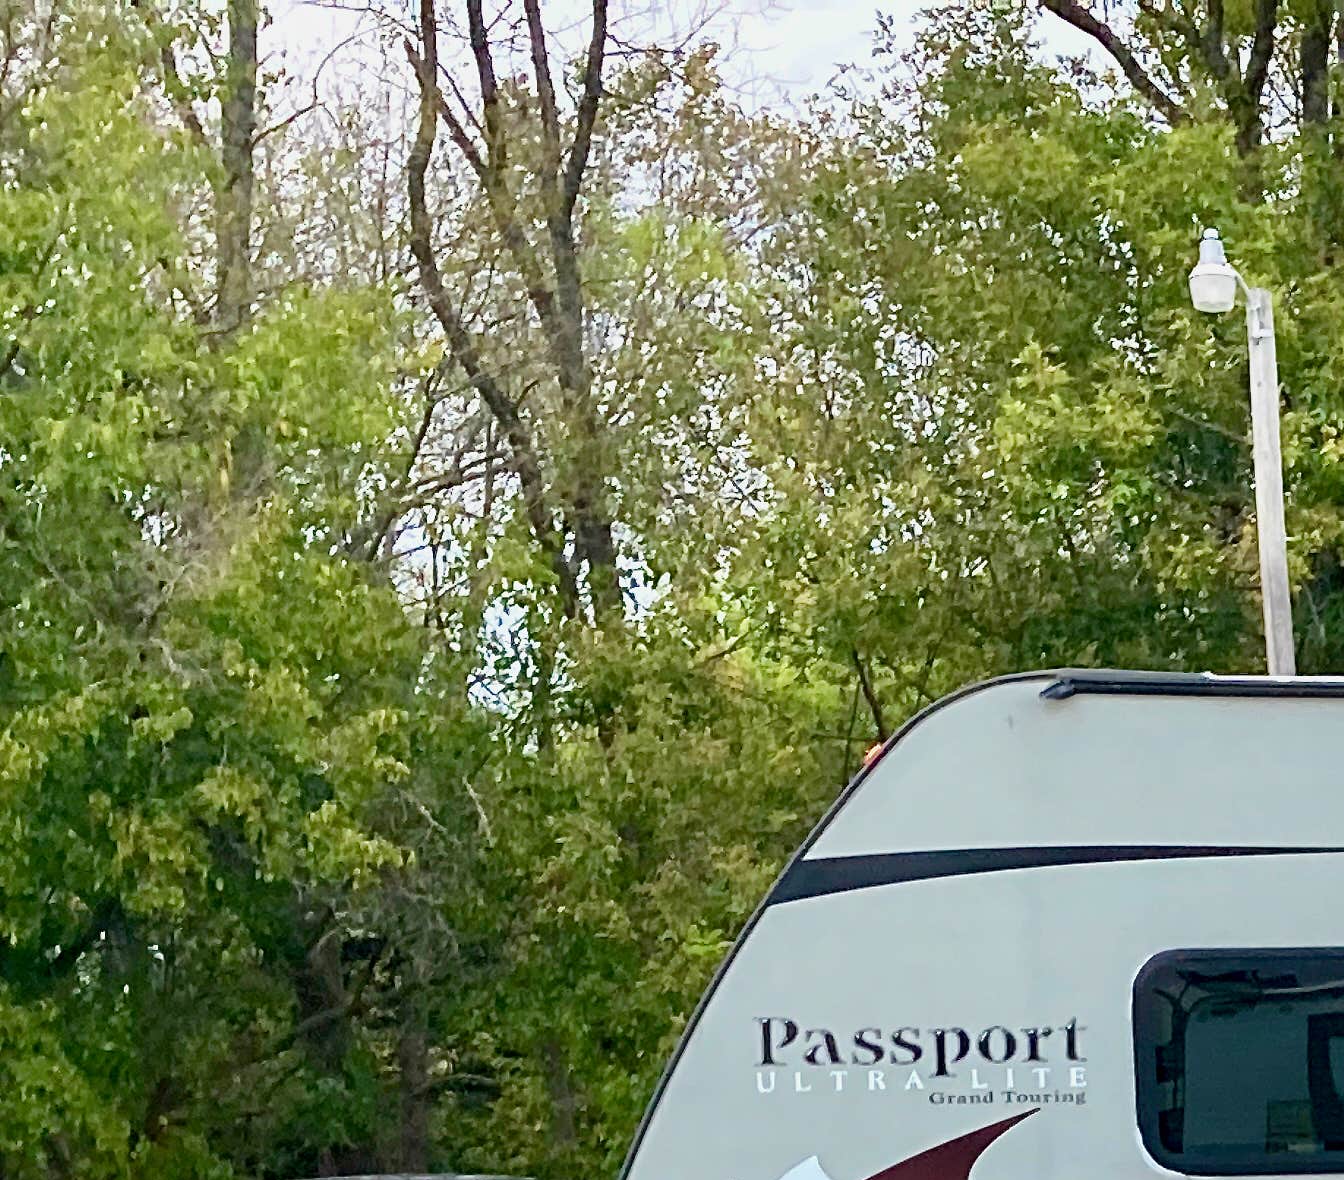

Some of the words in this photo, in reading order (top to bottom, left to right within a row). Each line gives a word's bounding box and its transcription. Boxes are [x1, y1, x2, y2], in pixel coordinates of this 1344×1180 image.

[753, 1015, 1089, 1079] Passport
[755, 1069, 925, 1094] ULTRA
[971, 1066, 1088, 1090] LITE
[928, 1090, 994, 1105] Grand
[1001, 1090, 1087, 1106] Touring
